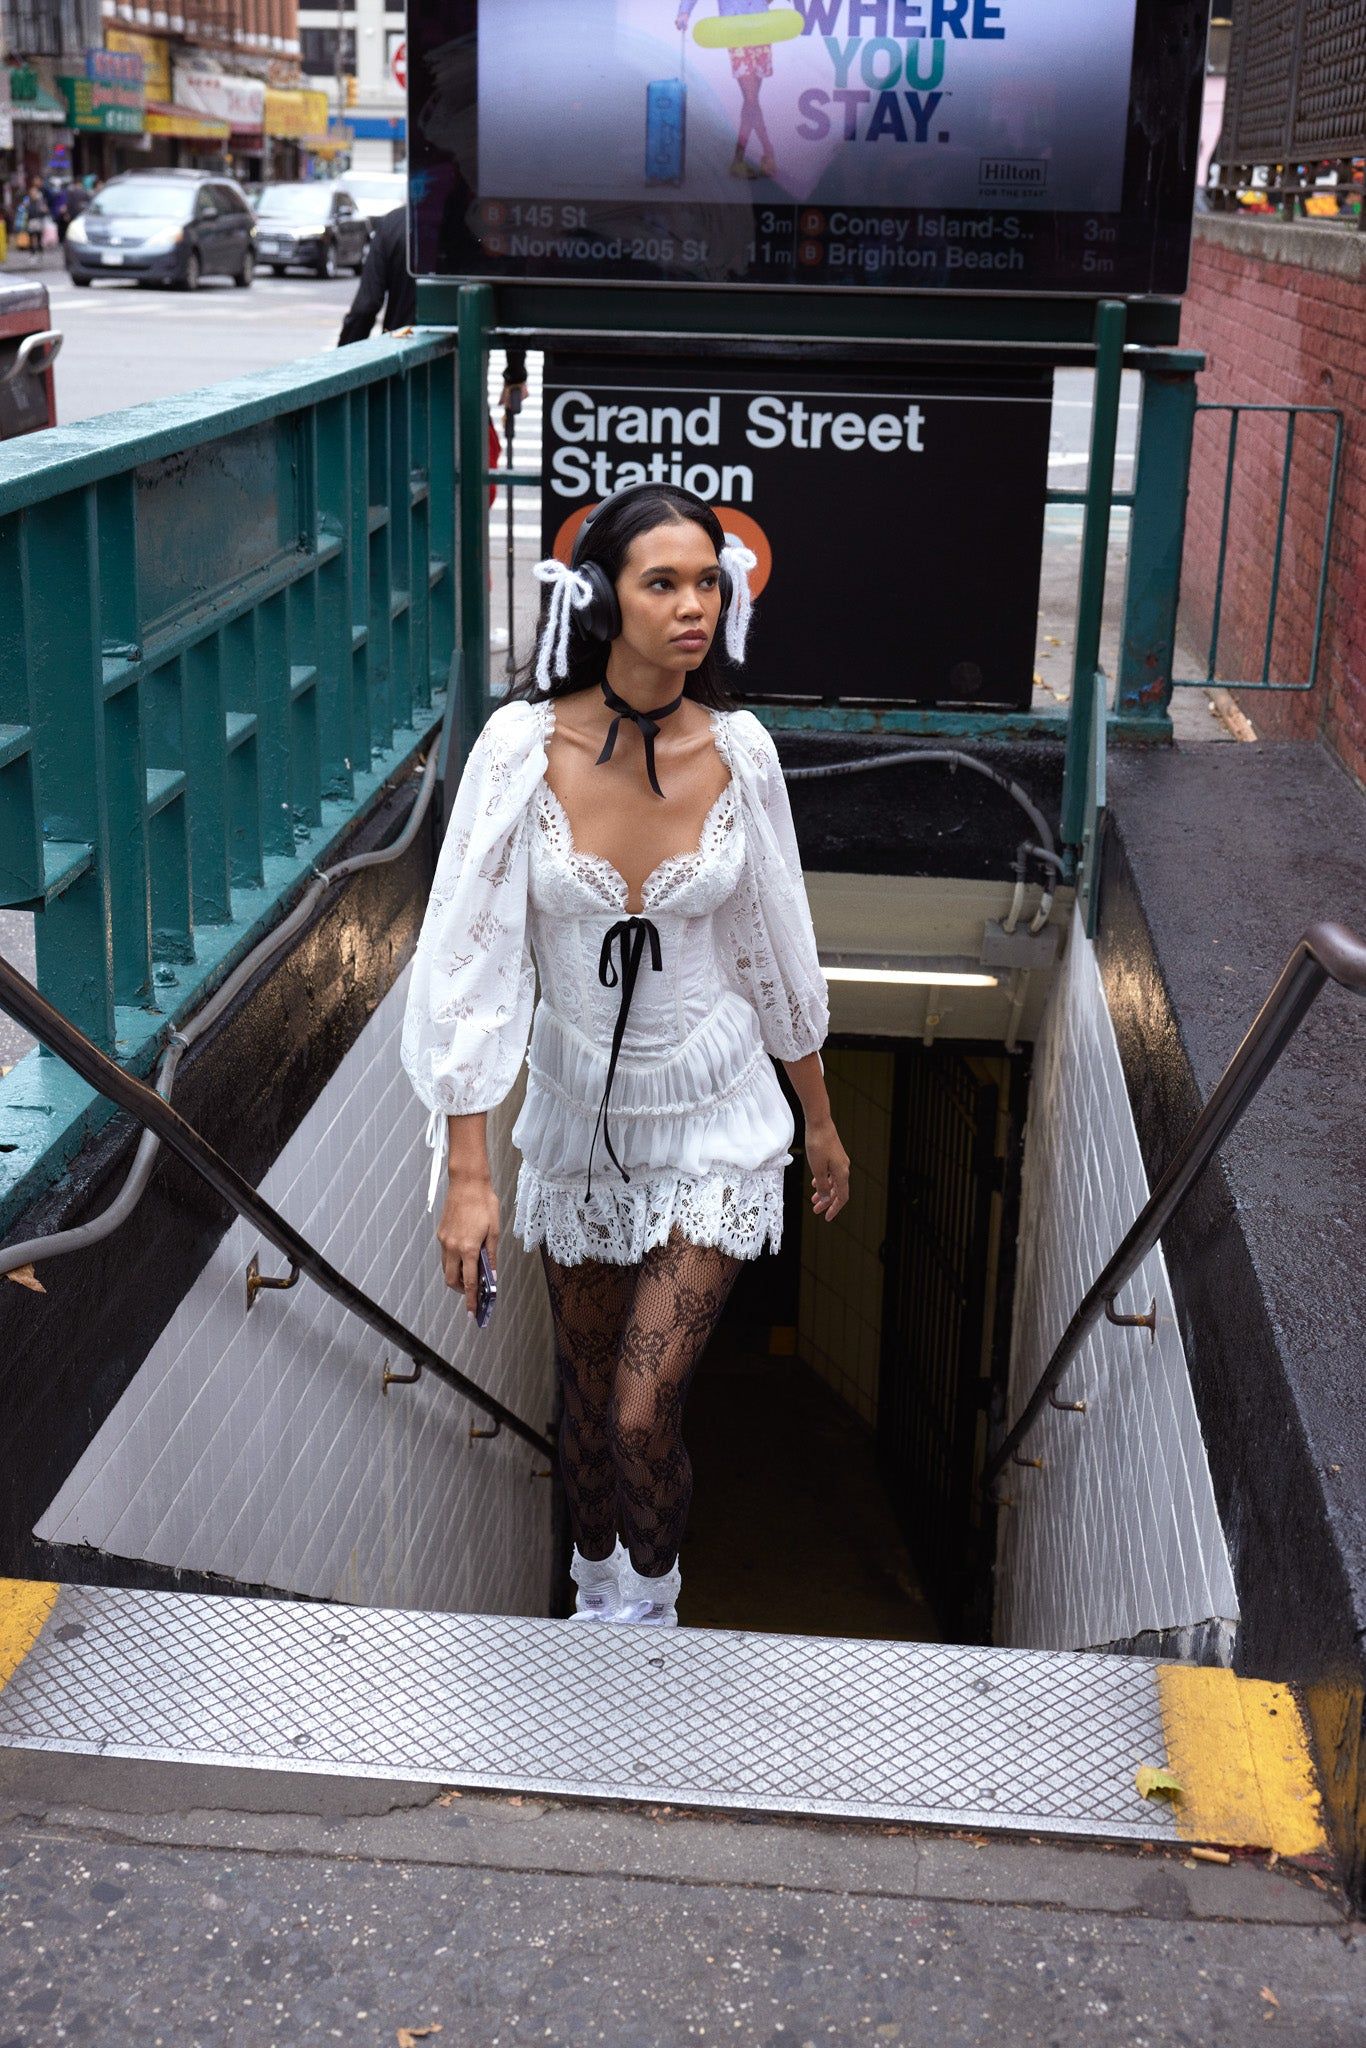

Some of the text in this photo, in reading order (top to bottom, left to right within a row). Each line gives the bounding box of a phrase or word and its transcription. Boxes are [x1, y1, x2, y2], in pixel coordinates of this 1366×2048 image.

[793, 0, 1005, 39] WHERE
[823, 36, 945, 91] YOU
[985, 164, 1040, 180] Hilton
[511, 206, 554, 226] 145
[561, 206, 588, 228] St
[761, 211, 792, 233] 3m
[829, 212, 910, 241] Coney
[918, 214, 1034, 240] Island-S..
[1084, 219, 1116, 241] 3m
[511, 235, 674, 262] Norwood-205
[682, 239, 708, 262] St
[747, 241, 792, 263] 11m
[829, 243, 936, 271] Brighton
[946, 246, 1024, 269] Beach
[1082, 250, 1114, 271] 5m
[551, 390, 925, 452] Grand Street
[550, 446, 753, 502] Station
